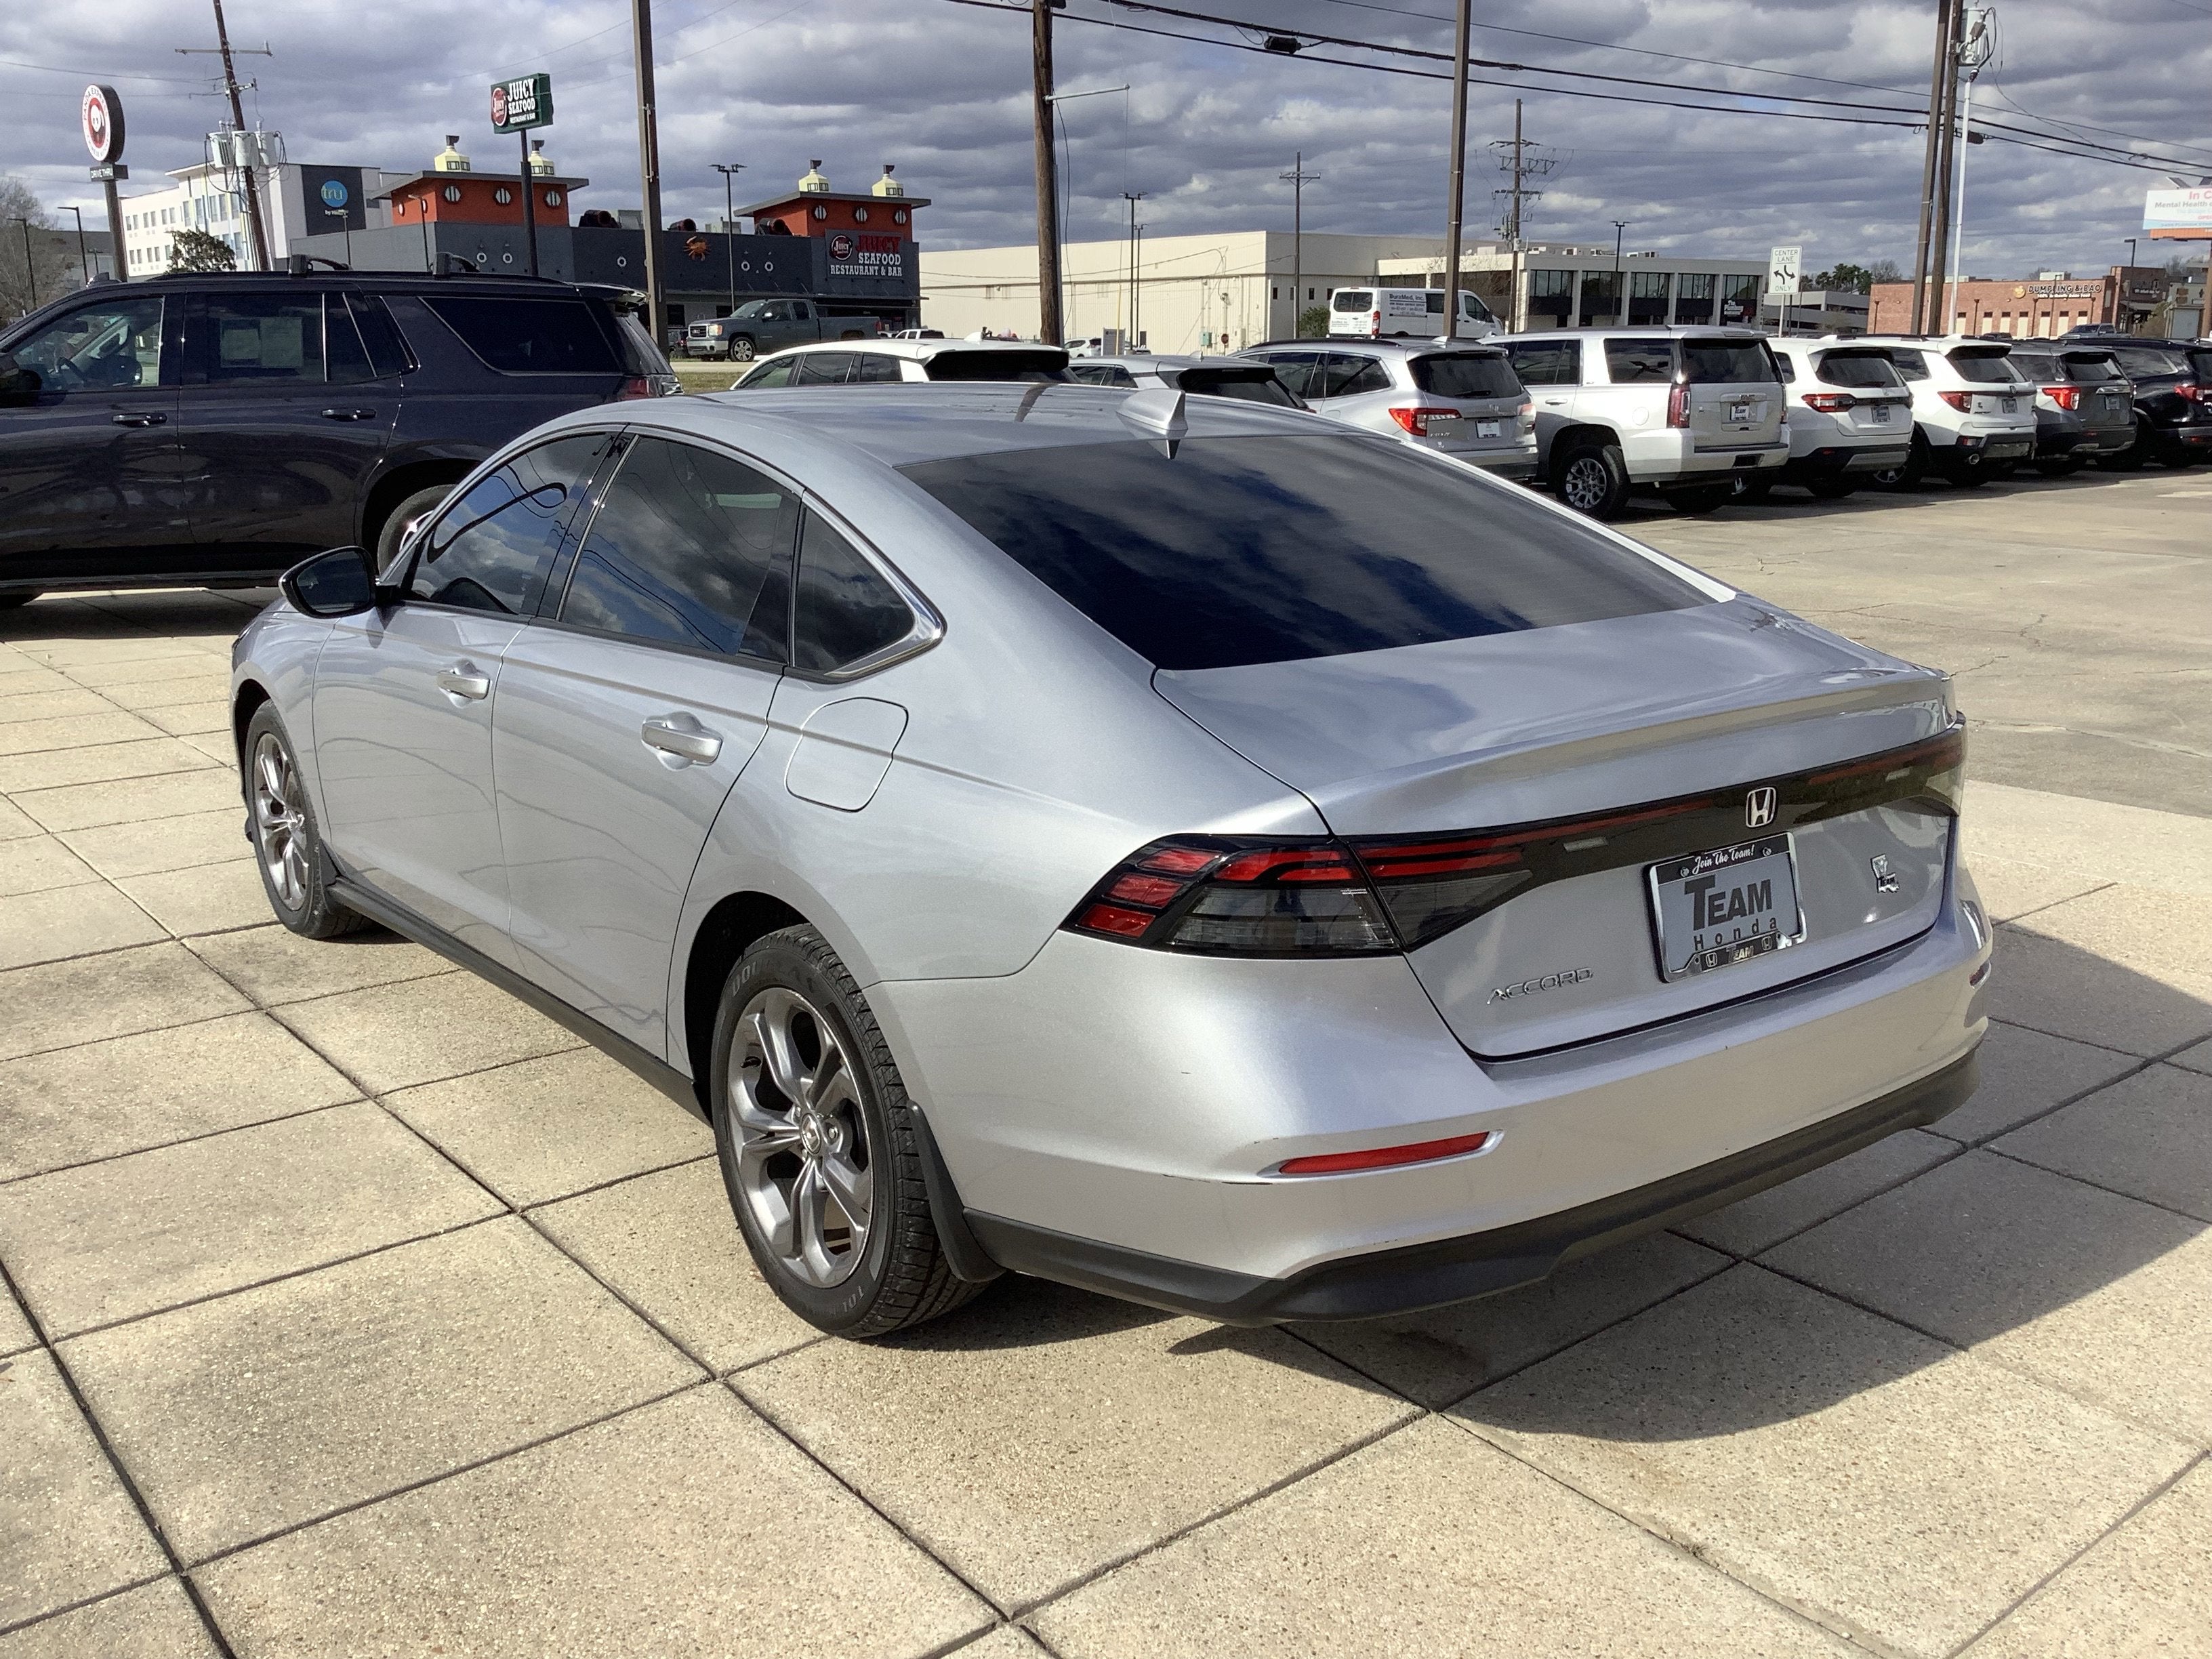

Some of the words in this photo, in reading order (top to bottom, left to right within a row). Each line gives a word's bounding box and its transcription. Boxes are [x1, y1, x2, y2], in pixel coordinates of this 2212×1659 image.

[508, 78, 534, 102] JUICY
[508, 97, 535, 115] SEAFOOD
[321, 185, 343, 200] tru
[2189, 191, 2200, 200] In
[855, 234, 901, 253] JUICY
[858, 252, 901, 265] SEAFOOD
[830, 265, 879, 275] RESTAURANT
[880, 266, 886, 276] &
[888, 267, 903, 276] BAR
[2084, 285, 2102, 293] BAO
[1692, 856, 1713, 875] Join
[1713, 851, 1729, 865] The
[1729, 844, 1755, 861] Team!
[1684, 874, 1772, 931] TEAM
[1694, 917, 1778, 951] Honda
[1726, 945, 1755, 963] TEAM
[1487, 967, 1593, 1005] ACCORD
